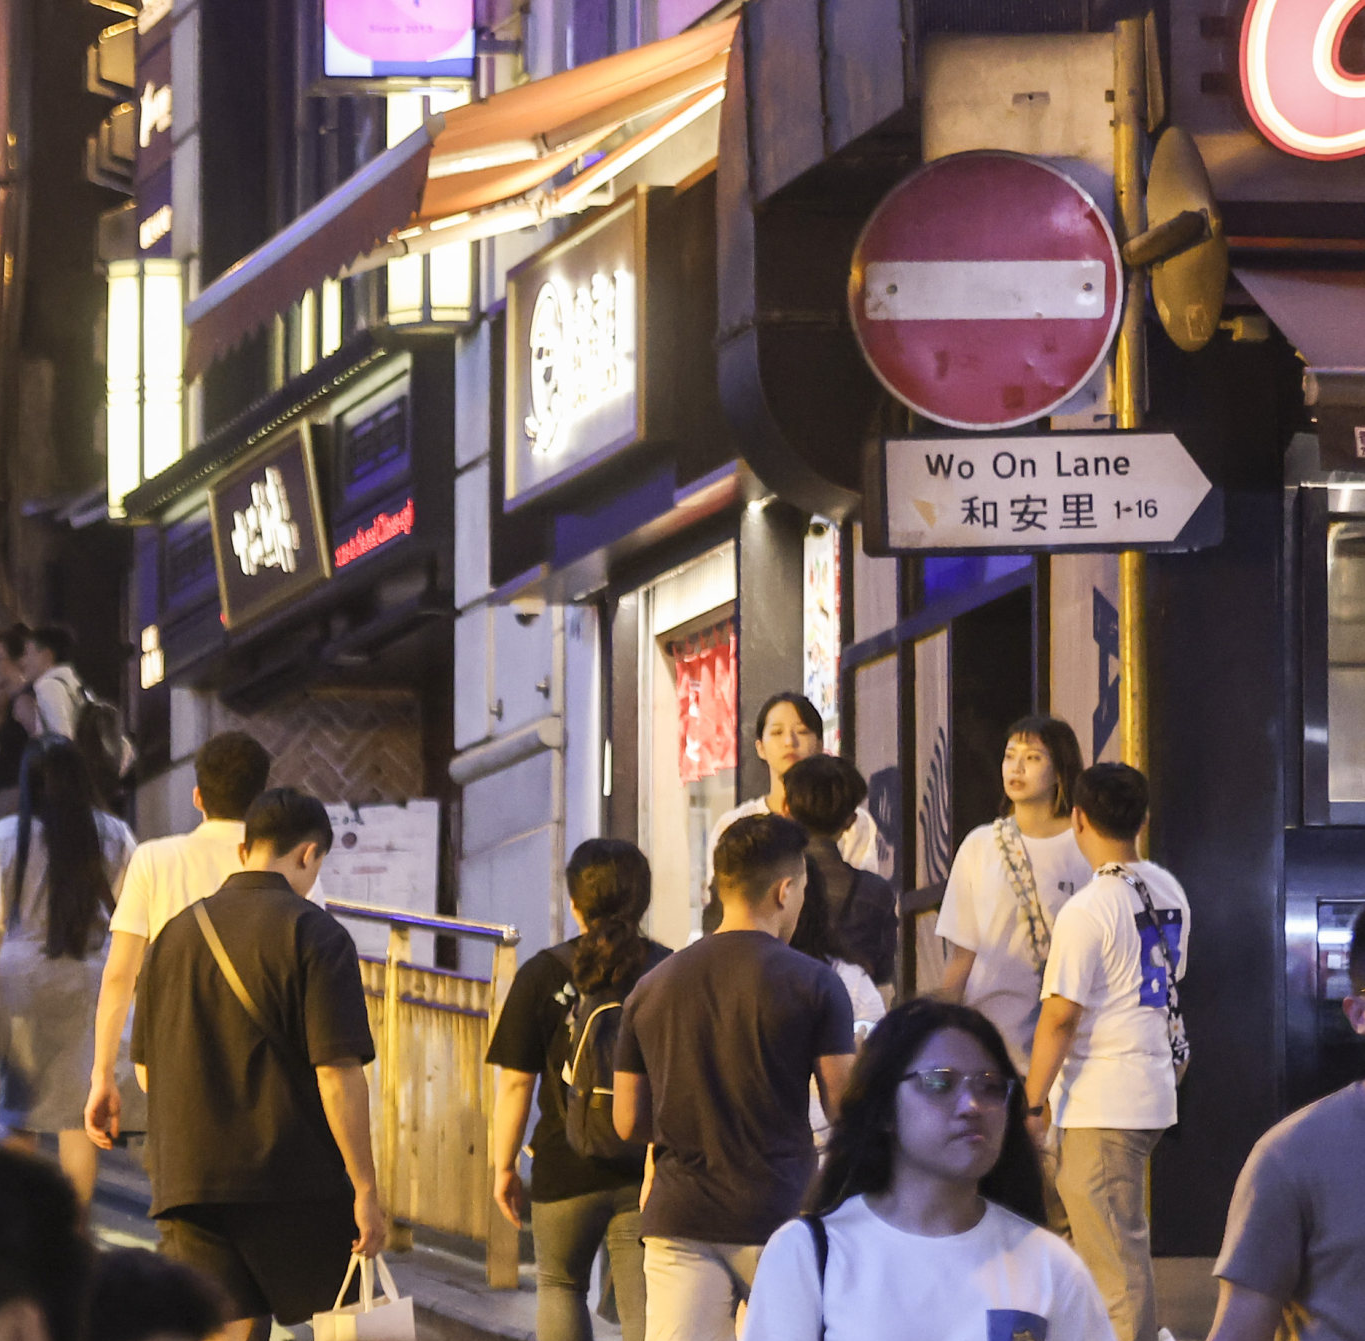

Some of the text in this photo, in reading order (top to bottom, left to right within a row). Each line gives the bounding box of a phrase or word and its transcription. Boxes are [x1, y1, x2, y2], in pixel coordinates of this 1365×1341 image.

[925, 450, 1131, 480] Wo On Lane
[961, 493, 1158, 532] 和安里 1-16
